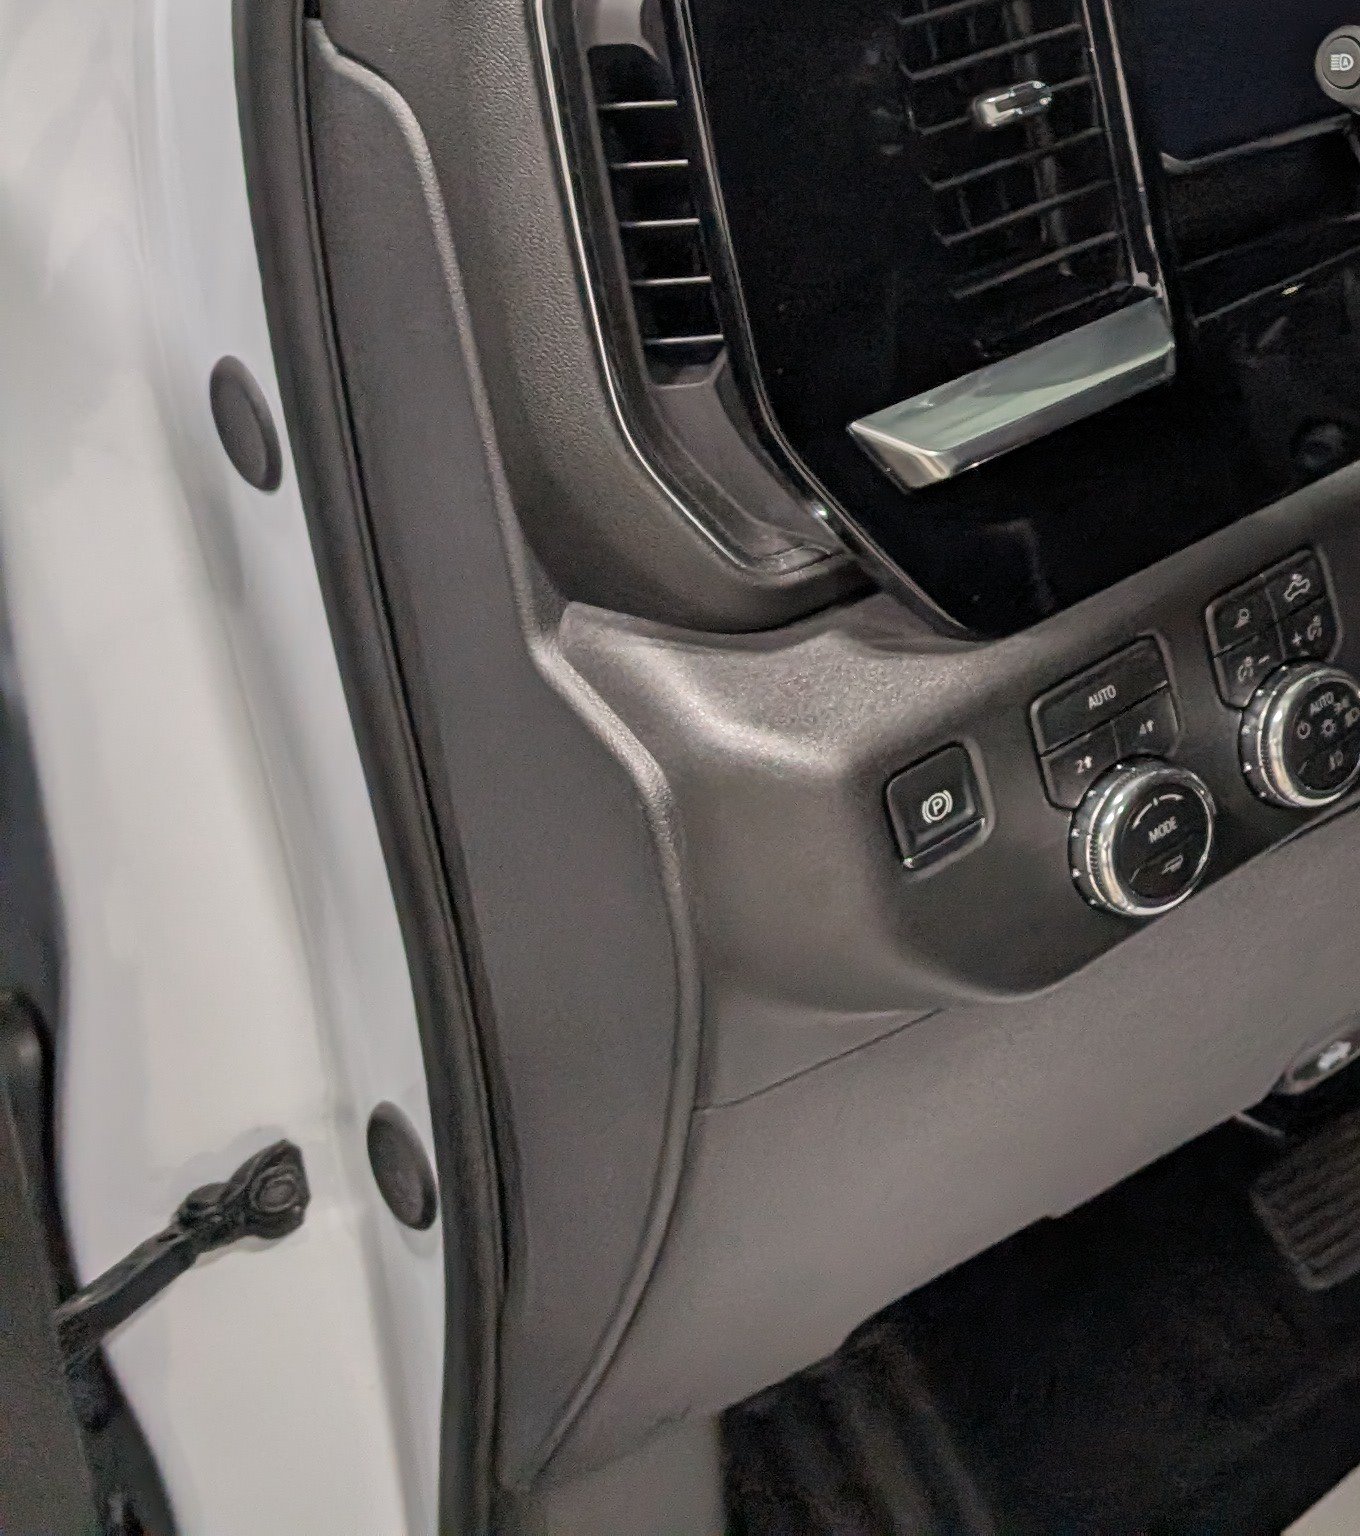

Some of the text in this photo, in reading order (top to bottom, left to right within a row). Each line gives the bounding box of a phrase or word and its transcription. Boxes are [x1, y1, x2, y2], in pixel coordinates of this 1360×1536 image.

[1088, 684, 1117, 710] AUTO
[1309, 691, 1335, 715] AUTO
[931, 797, 943, 815] P
[1148, 815, 1178, 843] MODE
